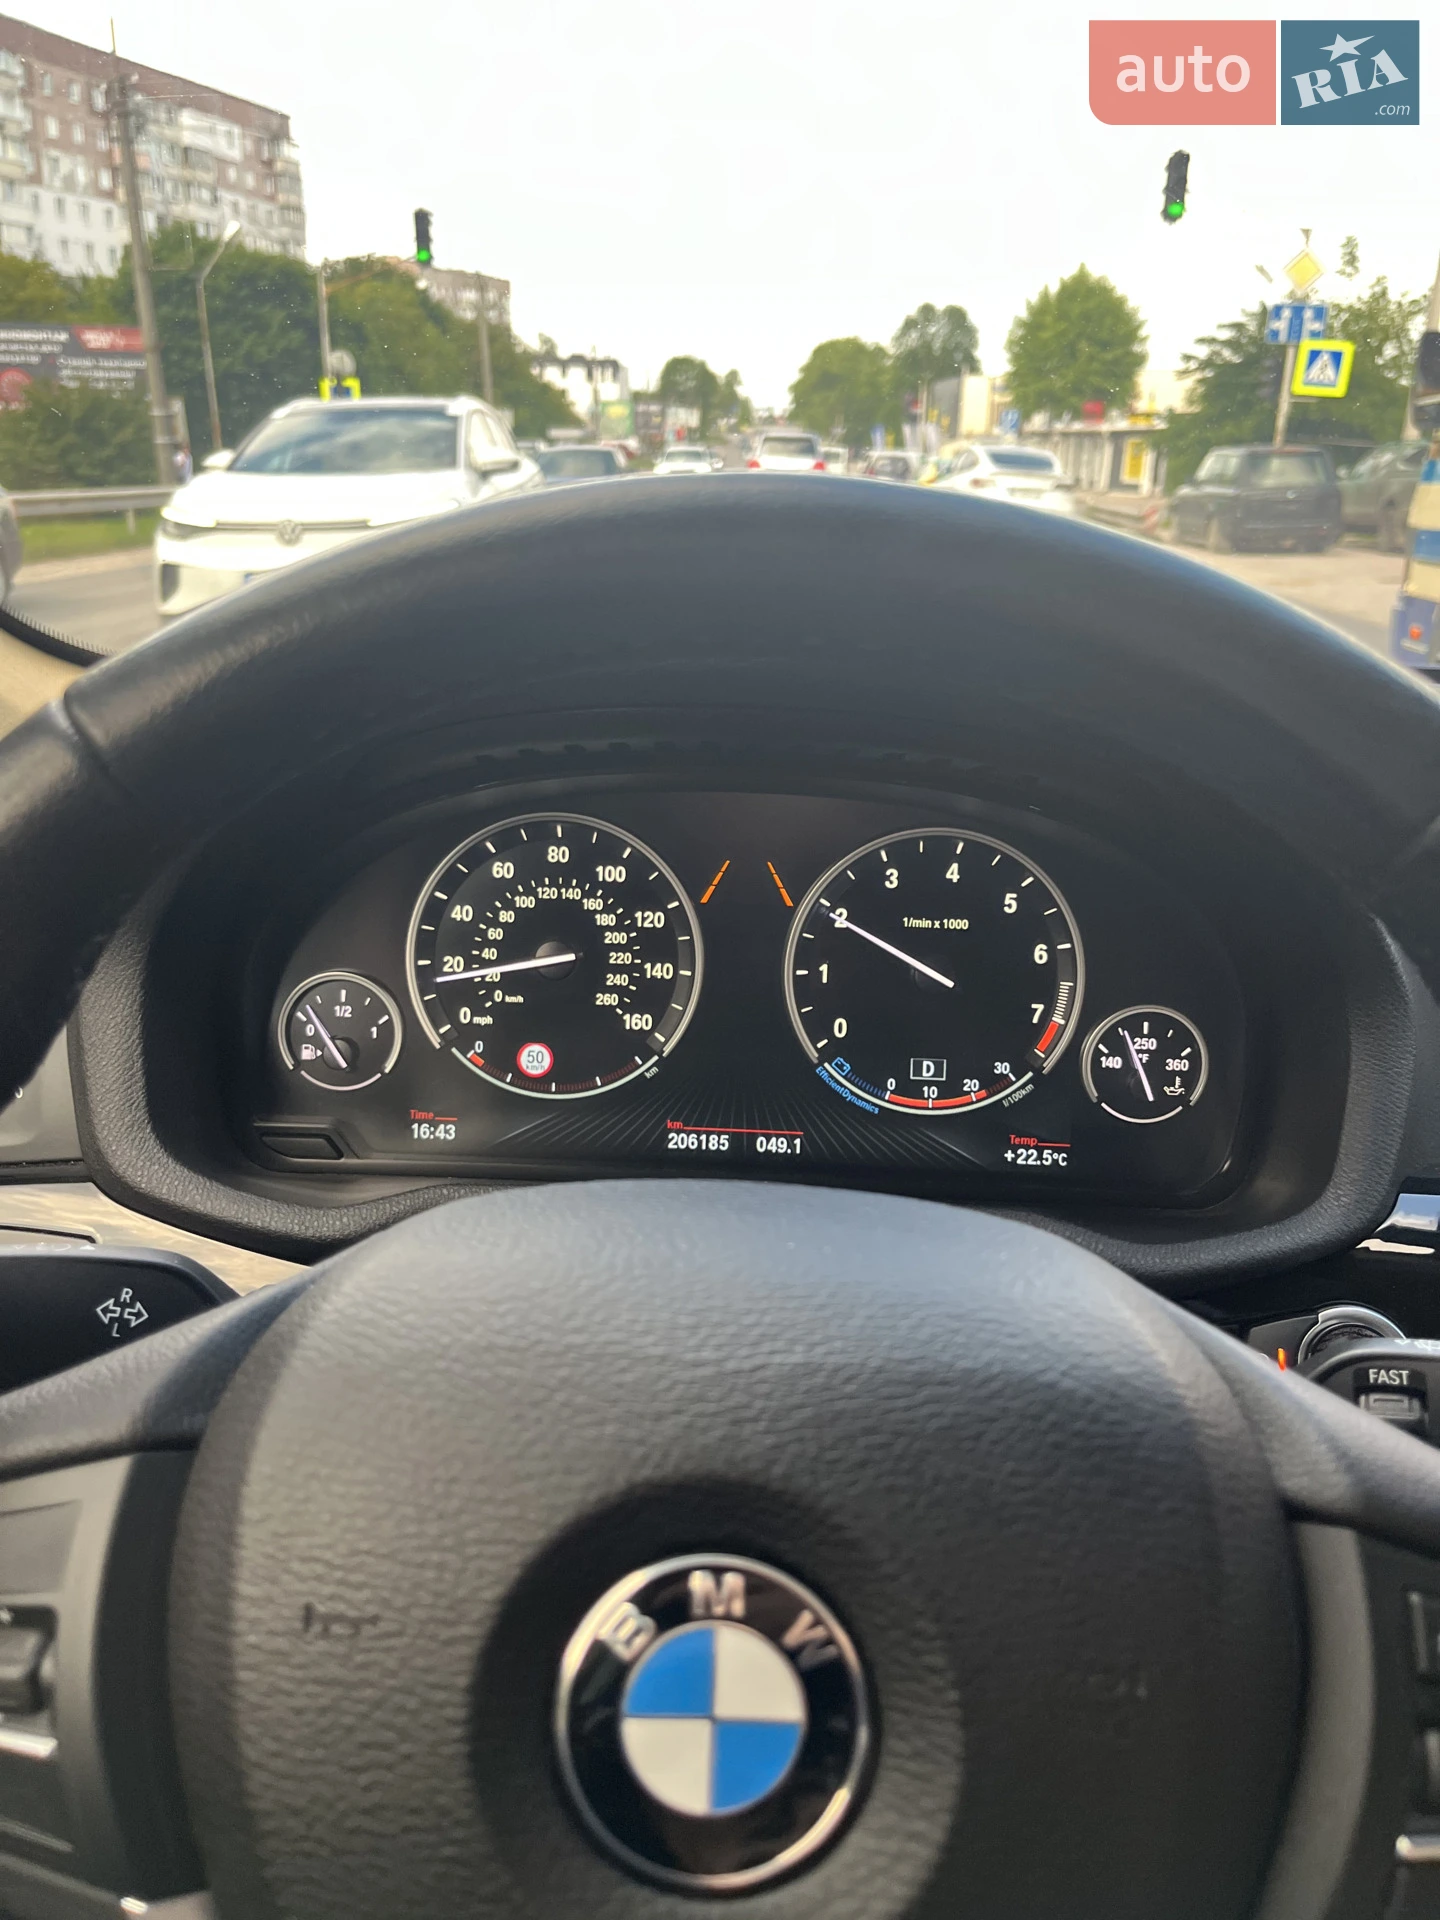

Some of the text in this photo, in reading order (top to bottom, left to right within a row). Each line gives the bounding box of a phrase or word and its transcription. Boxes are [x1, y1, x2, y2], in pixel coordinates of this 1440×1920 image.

[547, 845, 570, 863] 80
[491, 861, 515, 879] 60
[595, 865, 627, 883] 100
[945, 862, 961, 883] 4
[884, 868, 899, 889] 3
[536, 887, 558, 899] 120
[560, 887, 582, 900] 140
[514, 896, 536, 909] 100
[582, 898, 604, 911] 160
[1003, 892, 1018, 914] 5
[450, 904, 474, 922] 40
[498, 910, 515, 923] 80
[634, 911, 665, 928] 120
[833, 907, 848, 929] 2
[595, 914, 616, 927] 180
[902, 917, 969, 930] 1/min x 1000
[487, 928, 504, 940] 60
[604, 932, 628, 944] 200
[481, 947, 498, 960] 40
[608, 952, 632, 965] 220
[1033, 943, 1048, 964] 6
[442, 955, 465, 973] 20
[643, 962, 674, 980] 140
[484, 971, 501, 982] 20
[605, 974, 629, 986] 240
[818, 963, 829, 984] 1
[493, 989, 524, 1004] 0 km/h
[595, 993, 619, 1006] 260
[333, 1005, 353, 1018] 1/2
[459, 1006, 493, 1027] 0 mph
[1030, 1003, 1045, 1024] 7
[622, 1013, 653, 1030] 160
[833, 1017, 848, 1038] 0
[305, 1023, 315, 1037] 0
[370, 1026, 378, 1039] 1
[475, 1040, 484, 1053] 0
[1133, 1037, 1158, 1051] 250
[527, 1050, 544, 1064] 50
[1099, 1056, 1123, 1069] 140
[525, 1063, 546, 1072] km/h
[922, 1060, 935, 1078] D
[993, 1061, 1011, 1074] 30
[1164, 1058, 1190, 1072] 360
[643, 1065, 660, 1080] km
[815, 1065, 880, 1115] EfficientDynamics
[886, 1077, 896, 1091] 0
[962, 1079, 980, 1092] 20
[922, 1085, 938, 1099] 10
[410, 1109, 435, 1120] Time
[411, 1122, 456, 1140] 16:43
[667, 1119, 683, 1129] km
[667, 1132, 802, 1155] 206185 049.1
[1009, 1134, 1038, 1147] Temp
[120, 1287, 134, 1304] R
[111, 1322, 121, 1338] L
[1368, 1368, 1410, 1386] FAST
[594, 1568, 839, 1671] BMW
